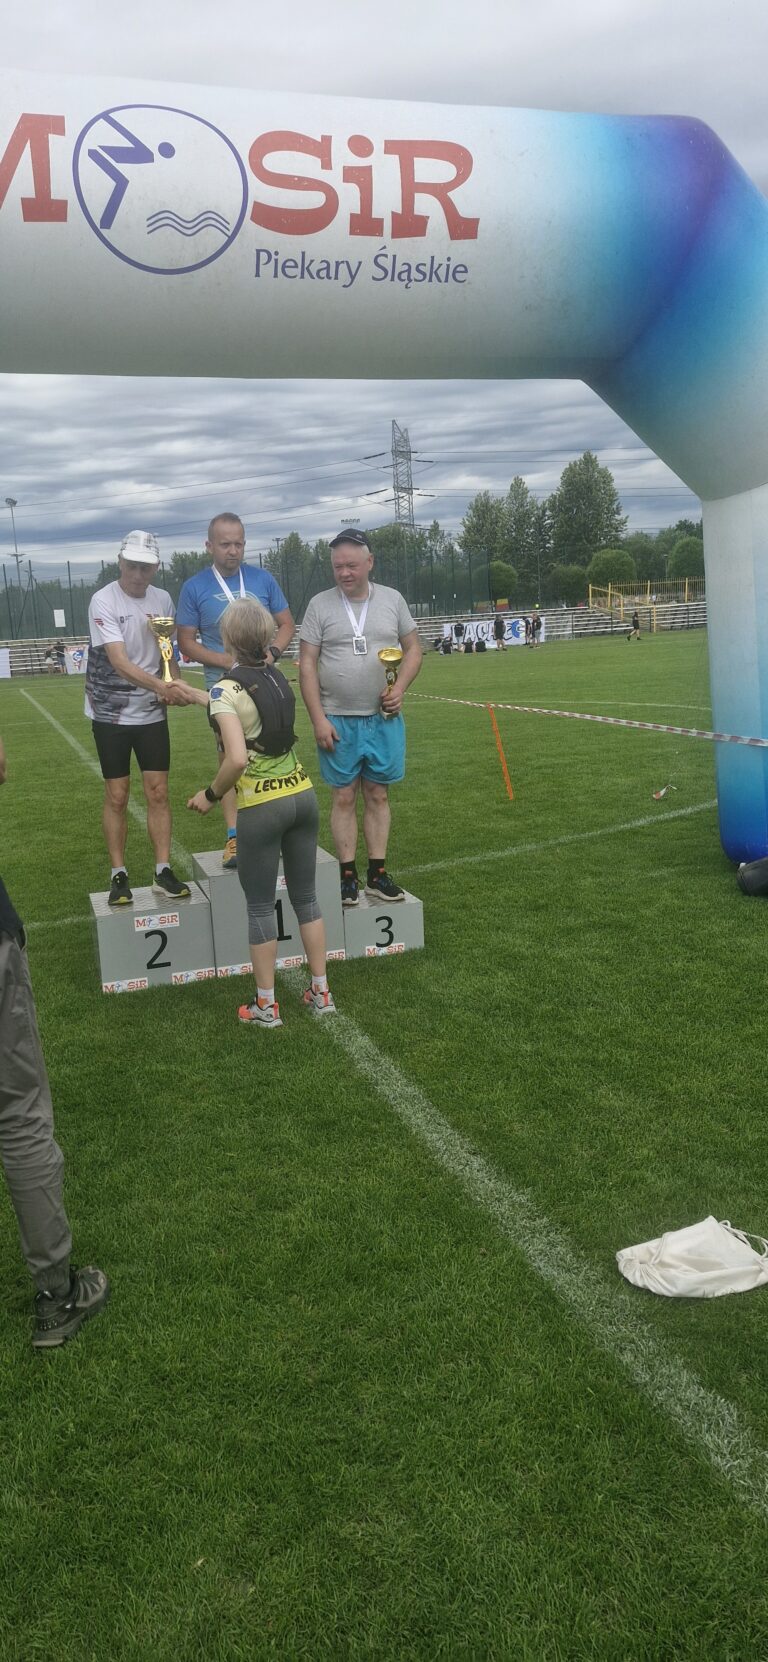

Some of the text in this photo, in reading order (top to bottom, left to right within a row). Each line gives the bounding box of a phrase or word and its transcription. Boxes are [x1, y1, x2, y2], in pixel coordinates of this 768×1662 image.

[254, 245, 469, 289] Piekary Śląskie
[275, 899, 292, 941] 1
[375, 915, 394, 948] 3
[144, 929, 172, 970] 2
